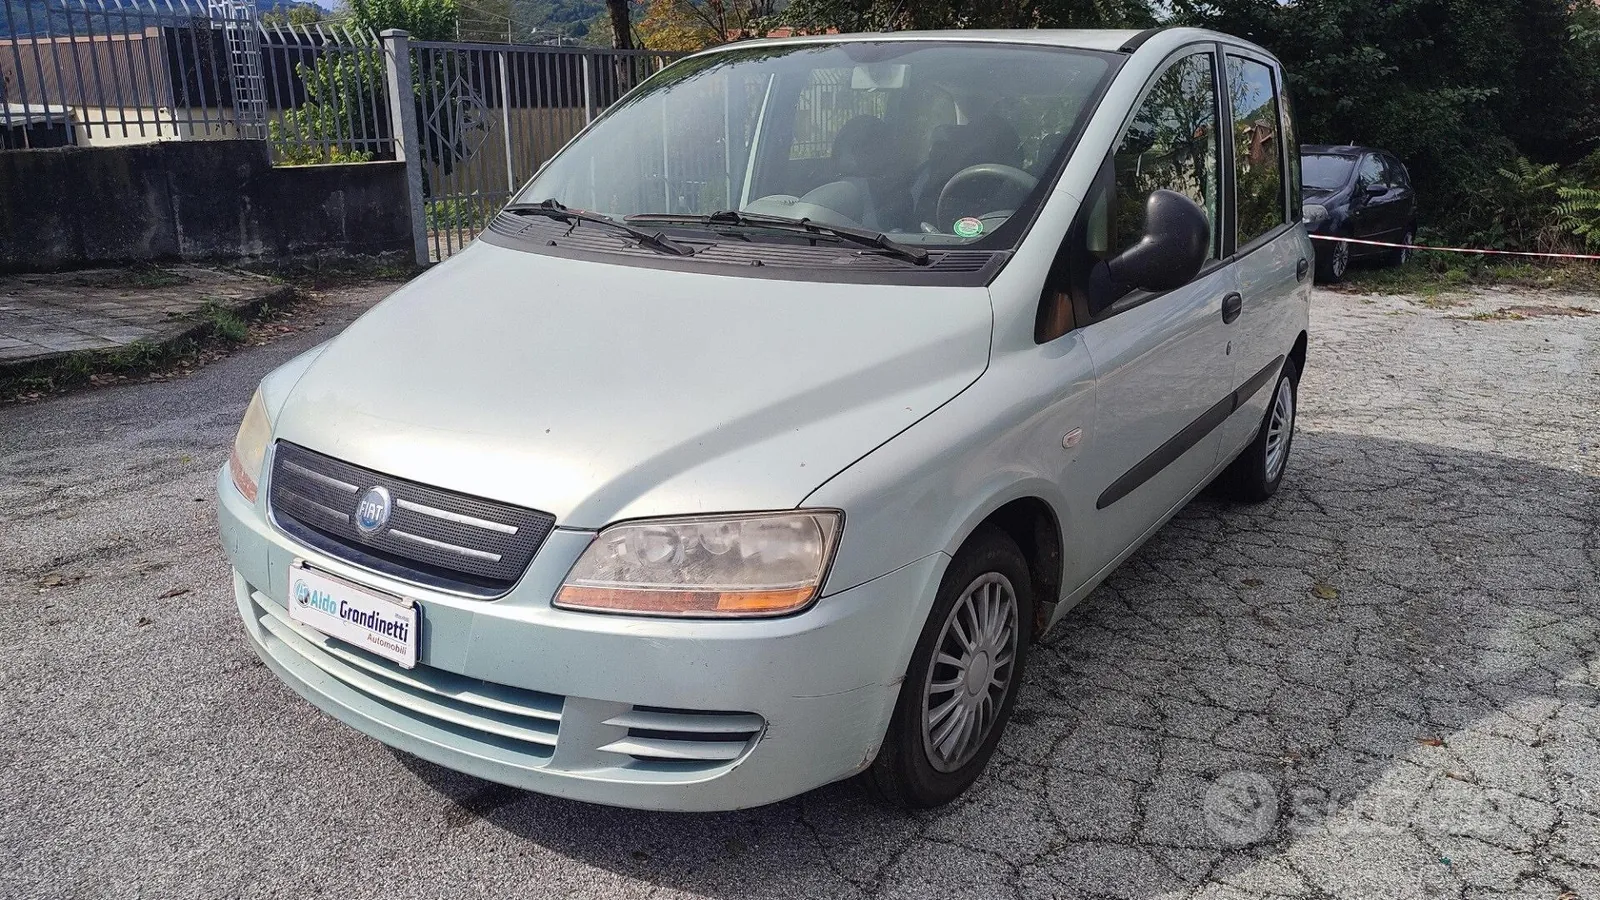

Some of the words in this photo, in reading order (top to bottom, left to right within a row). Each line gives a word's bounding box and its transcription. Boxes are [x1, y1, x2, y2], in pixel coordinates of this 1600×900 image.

[359, 500, 383, 520] FIAT
[310, 589, 336, 615] Aldo
[340, 600, 409, 643] Grandinetti
[367, 633, 407, 655] Automobili
